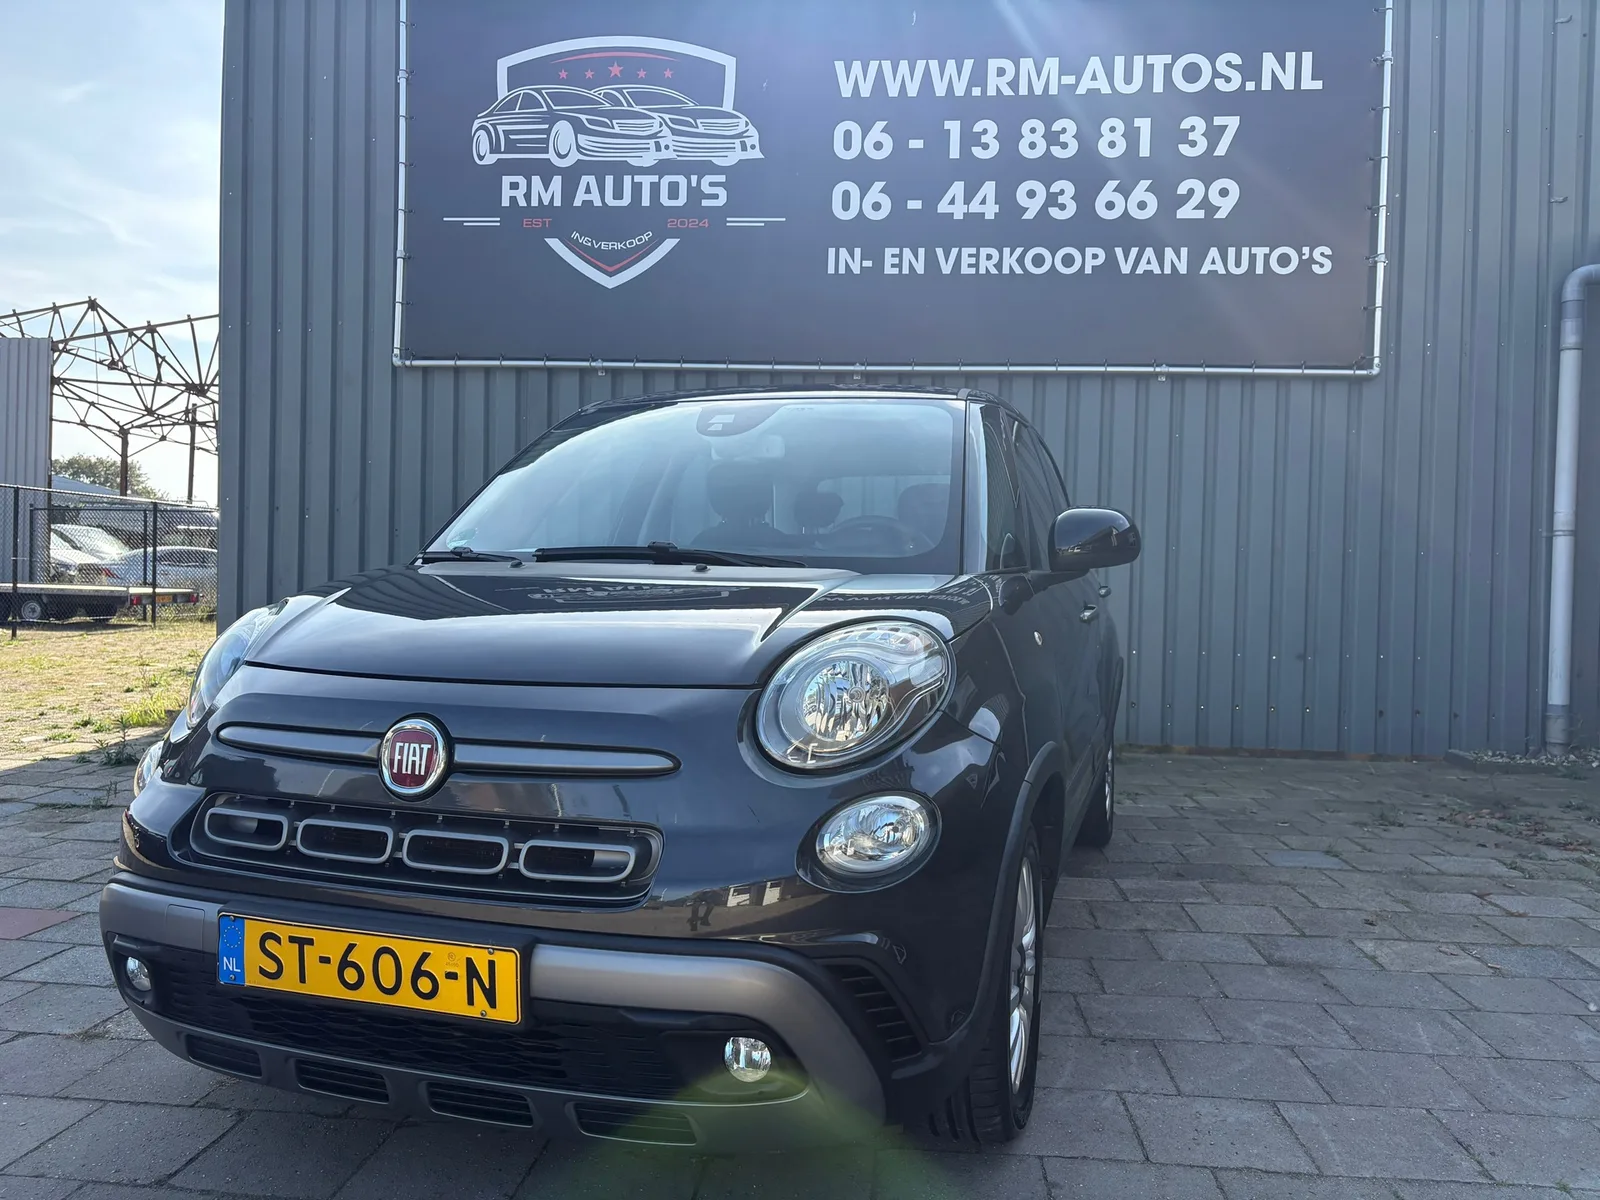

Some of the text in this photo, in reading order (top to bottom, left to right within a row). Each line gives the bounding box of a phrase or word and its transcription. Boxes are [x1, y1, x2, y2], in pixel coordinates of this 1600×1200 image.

[833, 51, 1323, 98] WWW.RM-AUTOS.NL
[833, 120, 894, 161] 06
[943, 119, 1000, 160] 13
[1018, 118, 1079, 159] 83
[1097, 117, 1152, 159] 81
[1177, 115, 1241, 158] 37
[501, 174, 728, 207] RM AUTO'S
[831, 180, 892, 221] 06
[936, 180, 1000, 220] 44
[1015, 179, 1077, 220] 93
[1094, 179, 1158, 220] 66
[1176, 177, 1240, 219] 29
[522, 218, 709, 228] EST 2024
[827, 245, 1333, 275] IN- EN VERKOOP VAN AUTO'S
[393, 742, 432, 776] FIAT
[223, 956, 241, 973] NL
[258, 931, 498, 1009] ST-606-N
